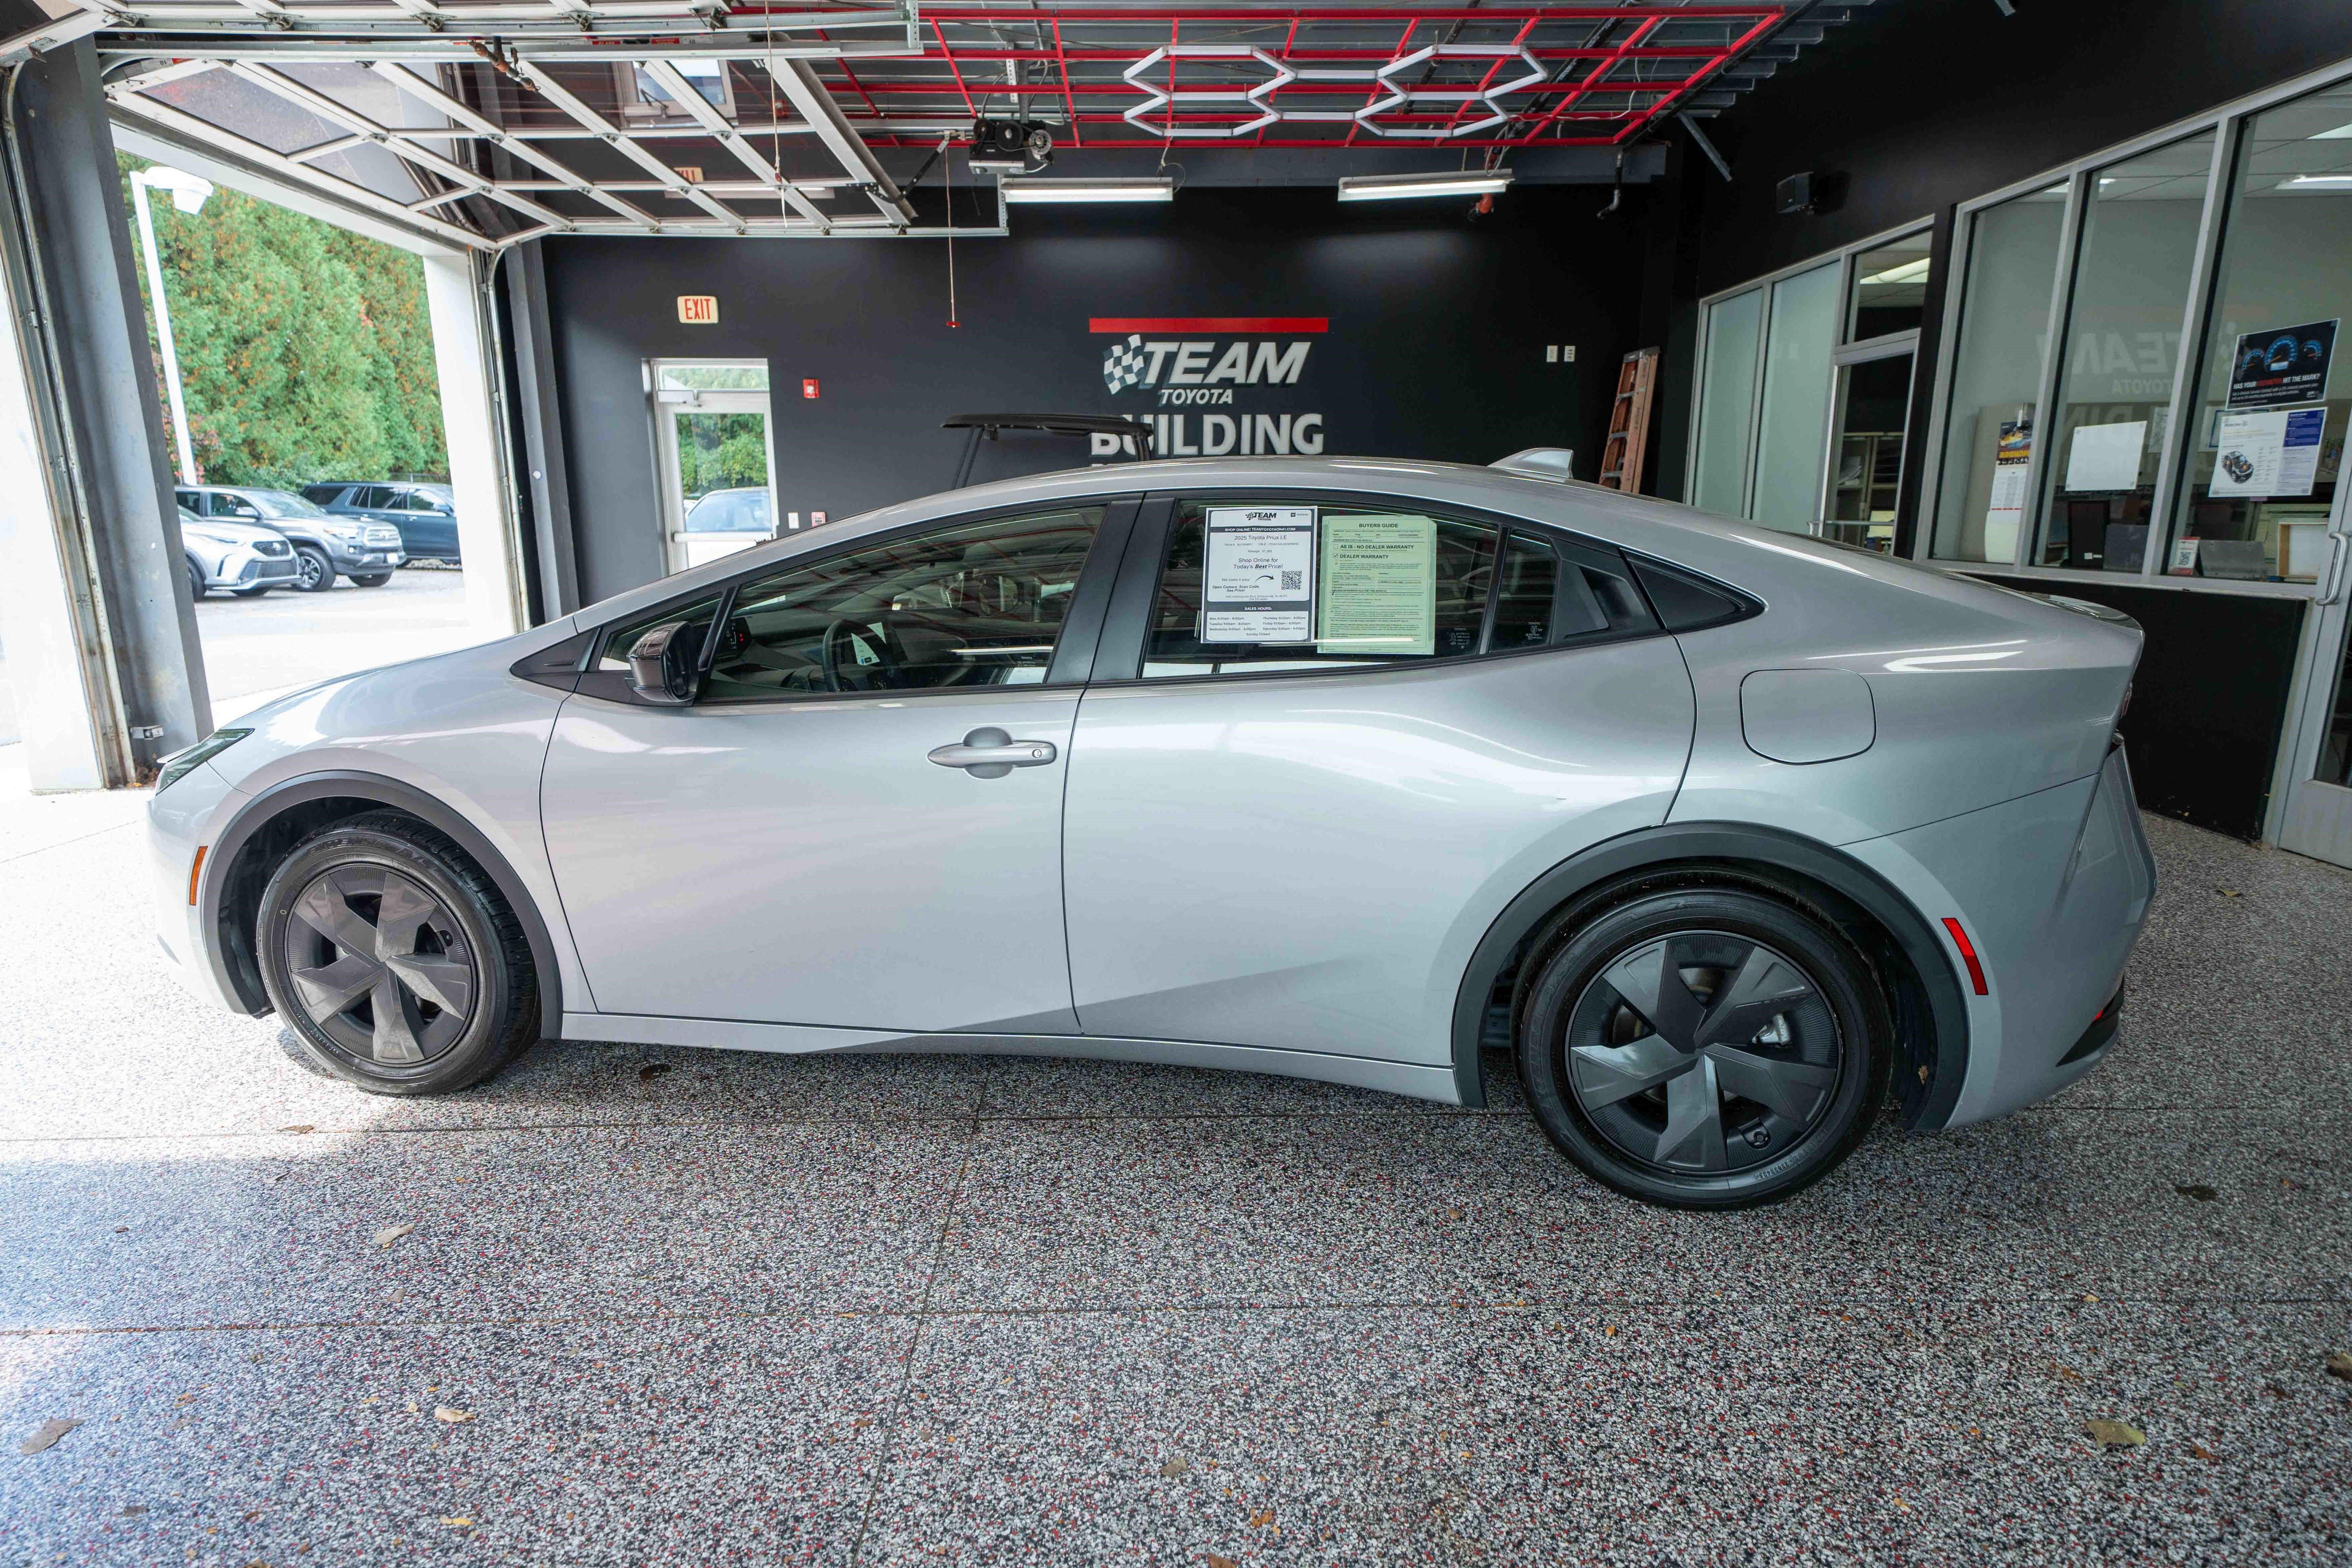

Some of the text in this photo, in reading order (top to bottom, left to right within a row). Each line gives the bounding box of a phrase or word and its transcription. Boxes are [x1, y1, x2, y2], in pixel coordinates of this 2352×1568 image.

[684, 298, 711, 320] EXIT
[1142, 341, 1311, 385] TEAM
[1160, 388, 1233, 405] TOYOTA
